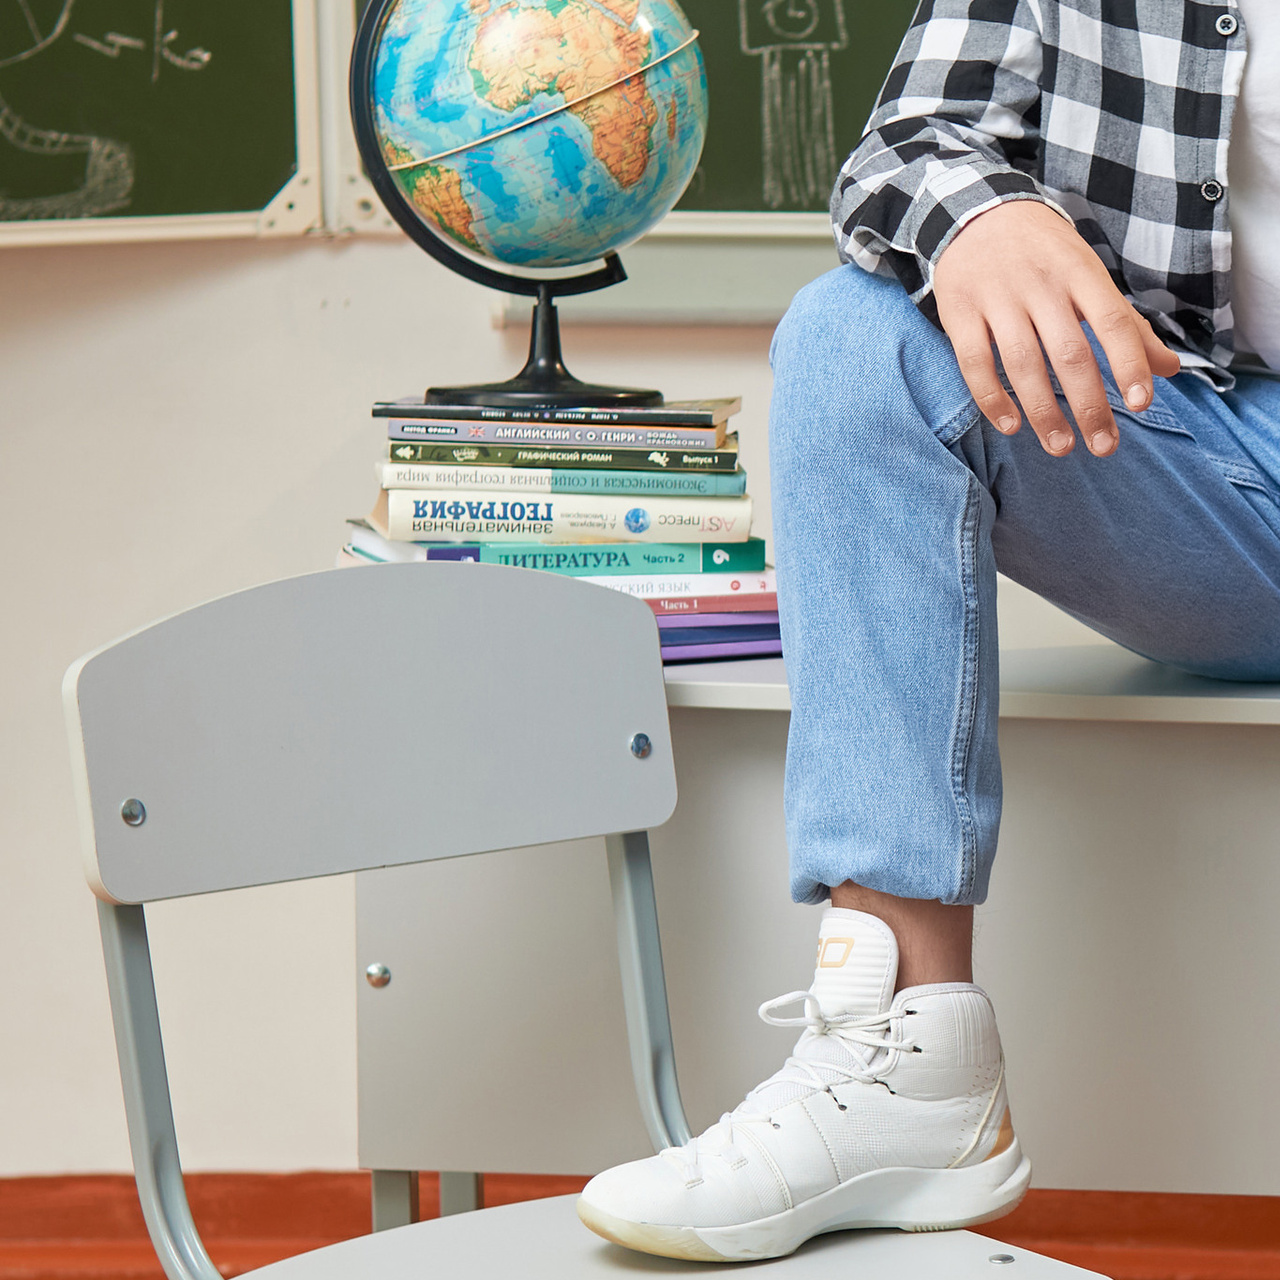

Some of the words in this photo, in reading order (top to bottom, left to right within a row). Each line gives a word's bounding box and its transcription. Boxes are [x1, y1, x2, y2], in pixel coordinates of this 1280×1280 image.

[496, 425, 571, 440] АНГЛИЙСКИЙ
[601, 431, 636, 443] ГЕНРИ
[517, 450, 580, 462] ГРАФИЧЕСКИЙ
[581, 453, 613, 463] РОМАН
[396, 470, 431, 482] мира
[435, 471, 506, 486] география
[510, 473, 587, 488] социальная
[591, 478, 599, 487] и
[604, 479, 707, 493] Экономическая
[413, 500, 554, 521] ГЕОГРАФИЯ
[412, 521, 553, 534] занимательная
[498, 551, 631, 568] ЛИТЕРАТУРА
[643, 553, 676, 564] Часть
[677, 552, 685, 563] 2
[660, 600, 690, 610] Часть
